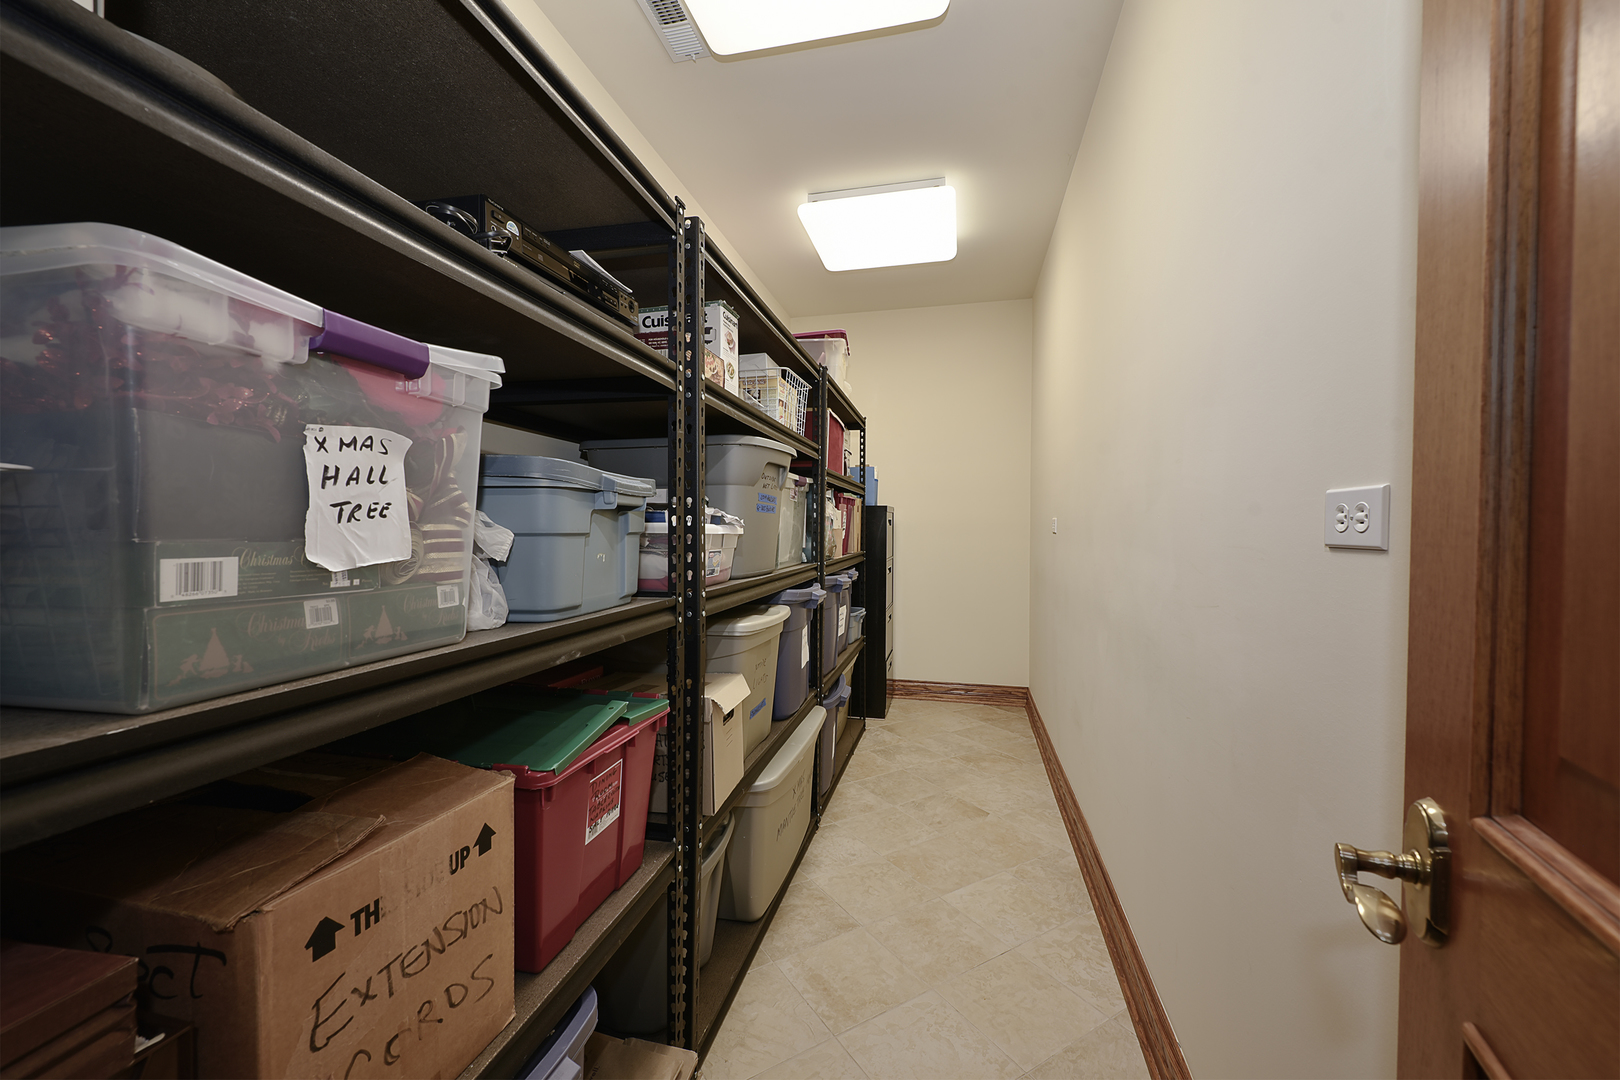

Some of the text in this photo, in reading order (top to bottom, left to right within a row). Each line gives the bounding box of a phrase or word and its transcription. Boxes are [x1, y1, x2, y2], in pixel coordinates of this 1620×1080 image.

[642, 314, 669, 329] Cuis
[321, 464, 390, 489] HALL
[329, 500, 392, 524] TREE
[236, 547, 294, 570] Christmas
[589, 767, 618, 793] DINING
[449, 845, 470, 875] UP
[309, 886, 503, 1053] EXTENSION
